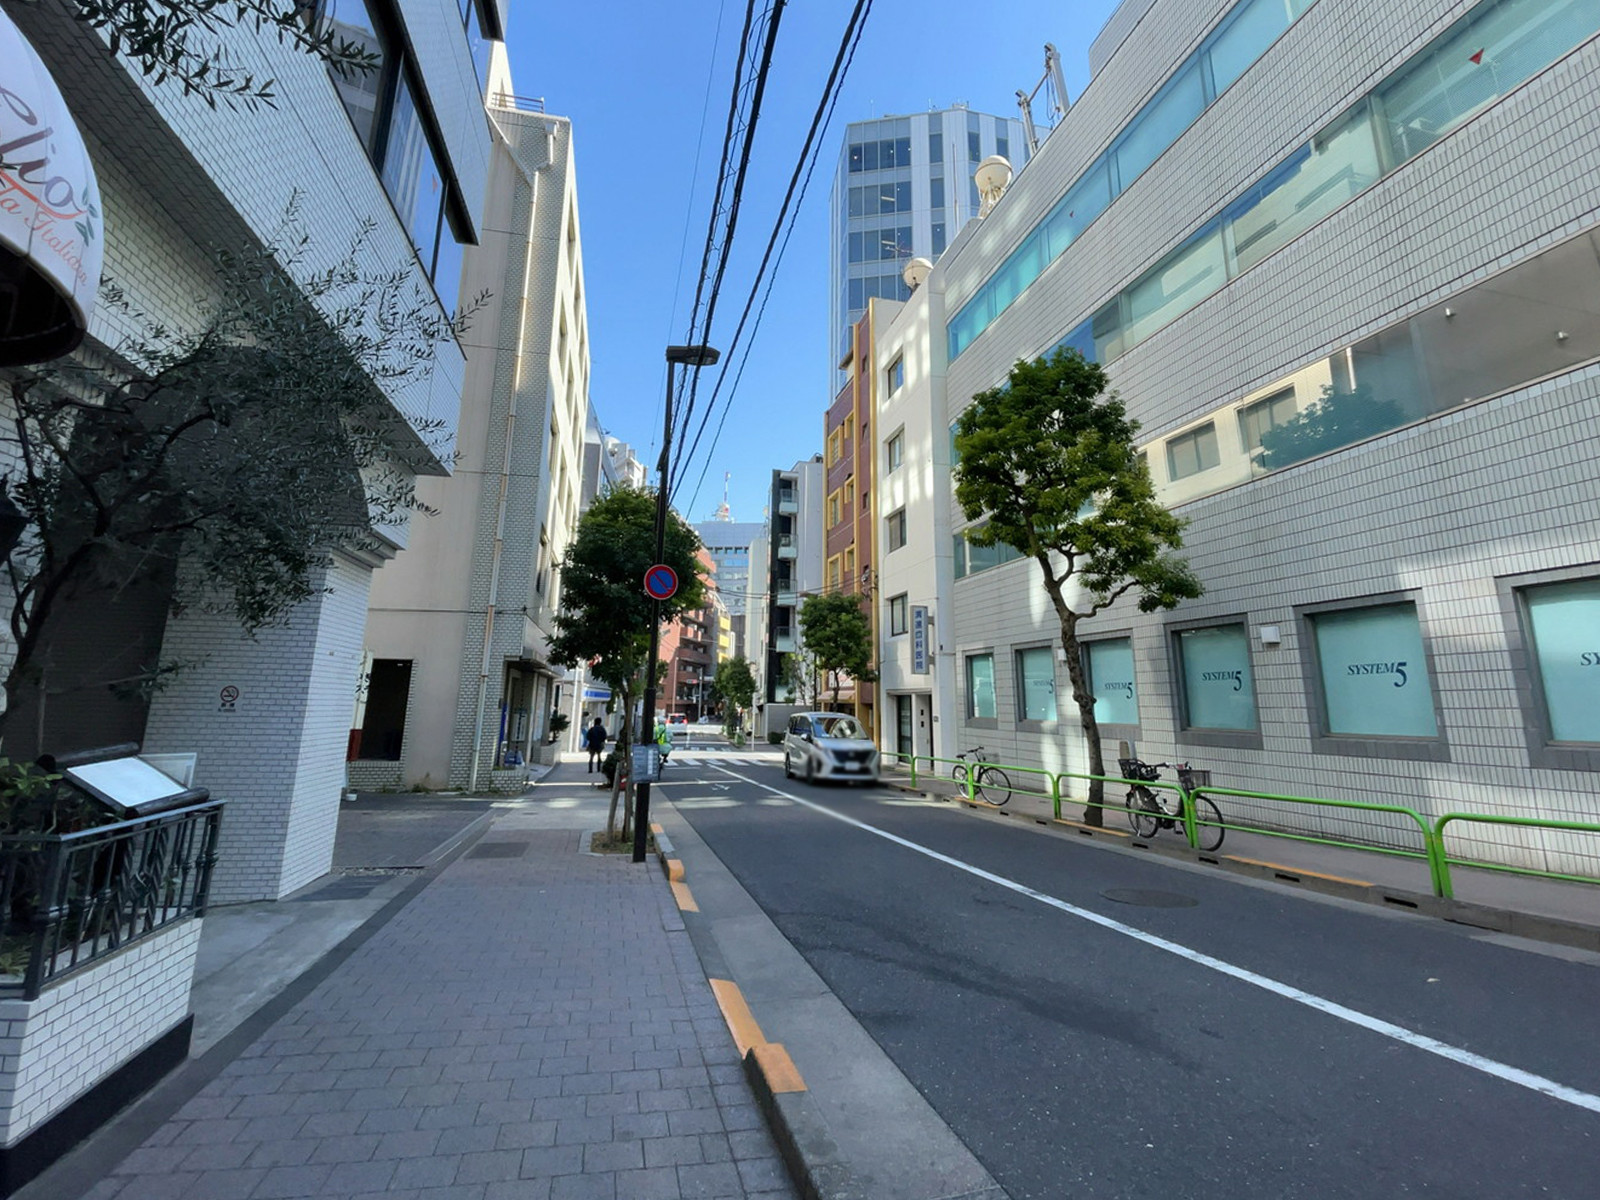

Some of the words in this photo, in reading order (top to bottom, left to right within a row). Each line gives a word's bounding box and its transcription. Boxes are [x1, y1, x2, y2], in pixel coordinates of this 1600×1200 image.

[914, 609, 924, 670] 歯科医院
[1202, 671, 1242, 691] SYSTEM5
[1347, 662, 1407, 688] SYSTEM5
